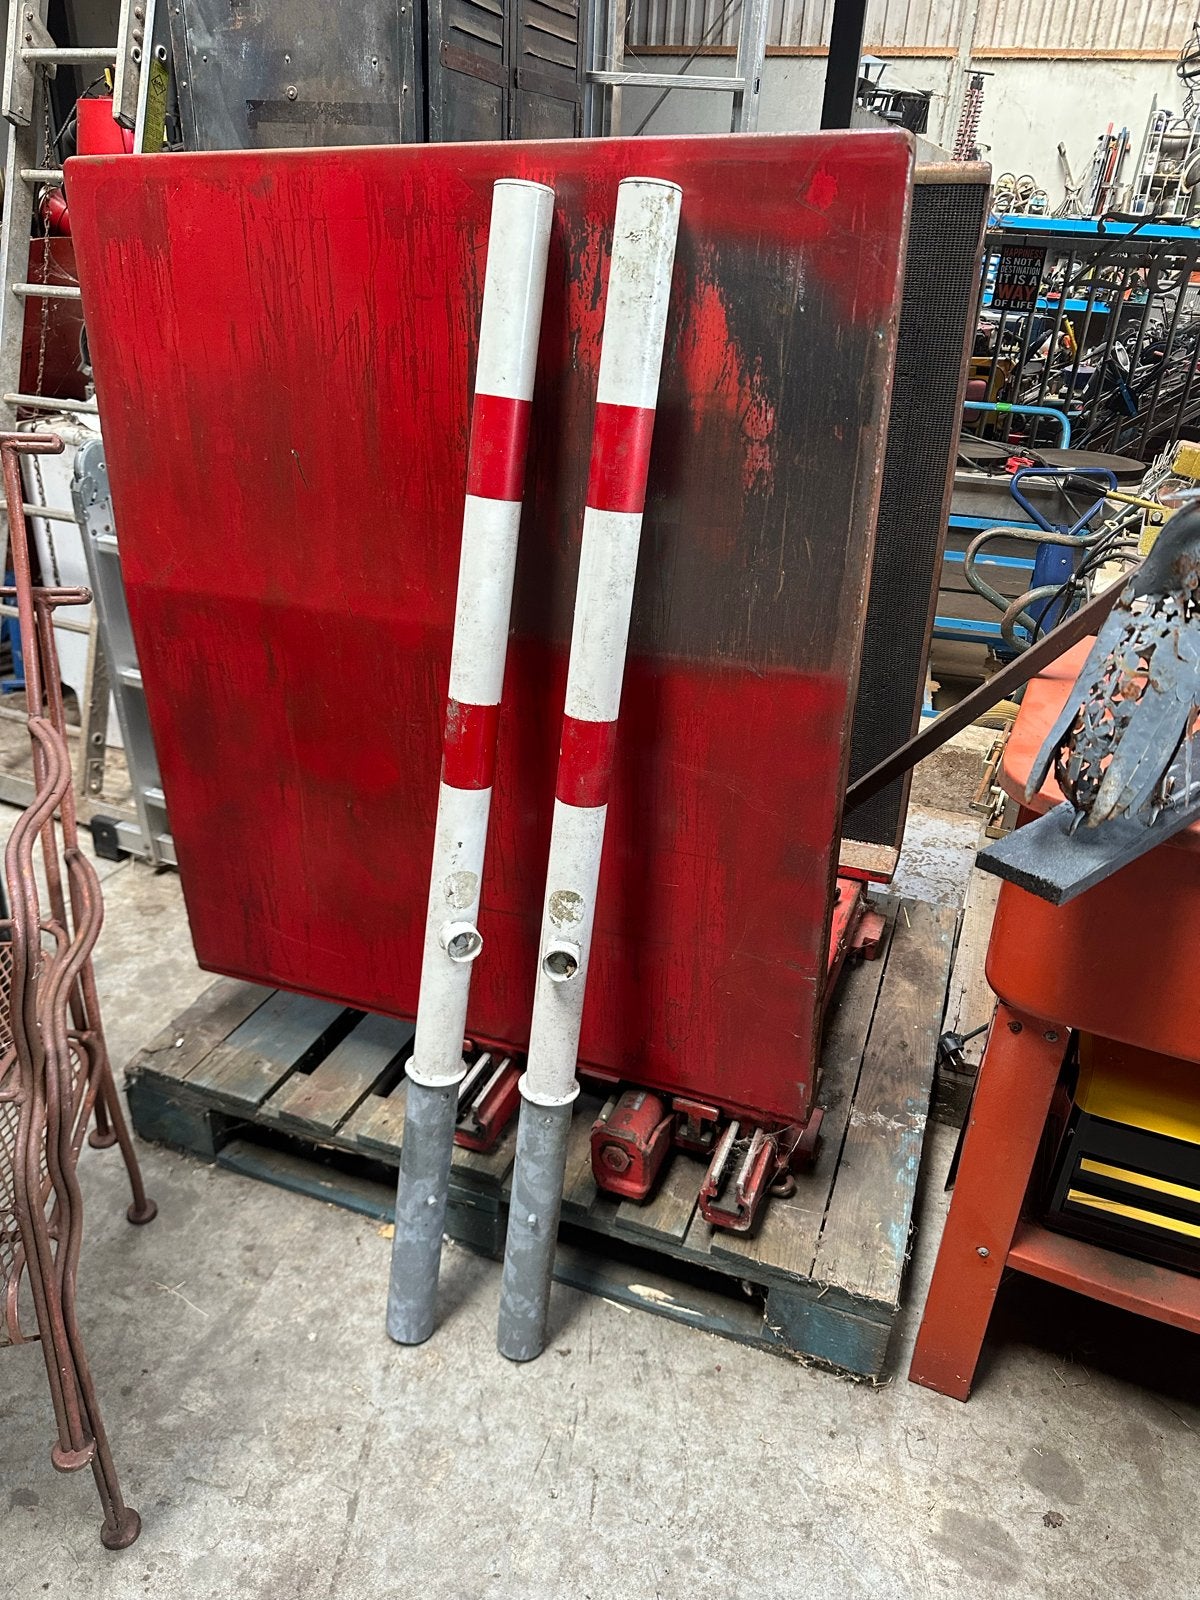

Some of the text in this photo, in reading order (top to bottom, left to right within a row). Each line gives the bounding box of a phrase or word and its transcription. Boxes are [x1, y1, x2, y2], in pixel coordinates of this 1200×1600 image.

[1004, 248, 1044, 258] HAPPINESS
[1014, 258, 1033, 266] NOT
[1001, 265, 1040, 275] DESTINATION
[999, 274, 1037, 286] IT IS A
[998, 284, 1036, 301] WAY
[1011, 300, 1034, 309] LIFE
